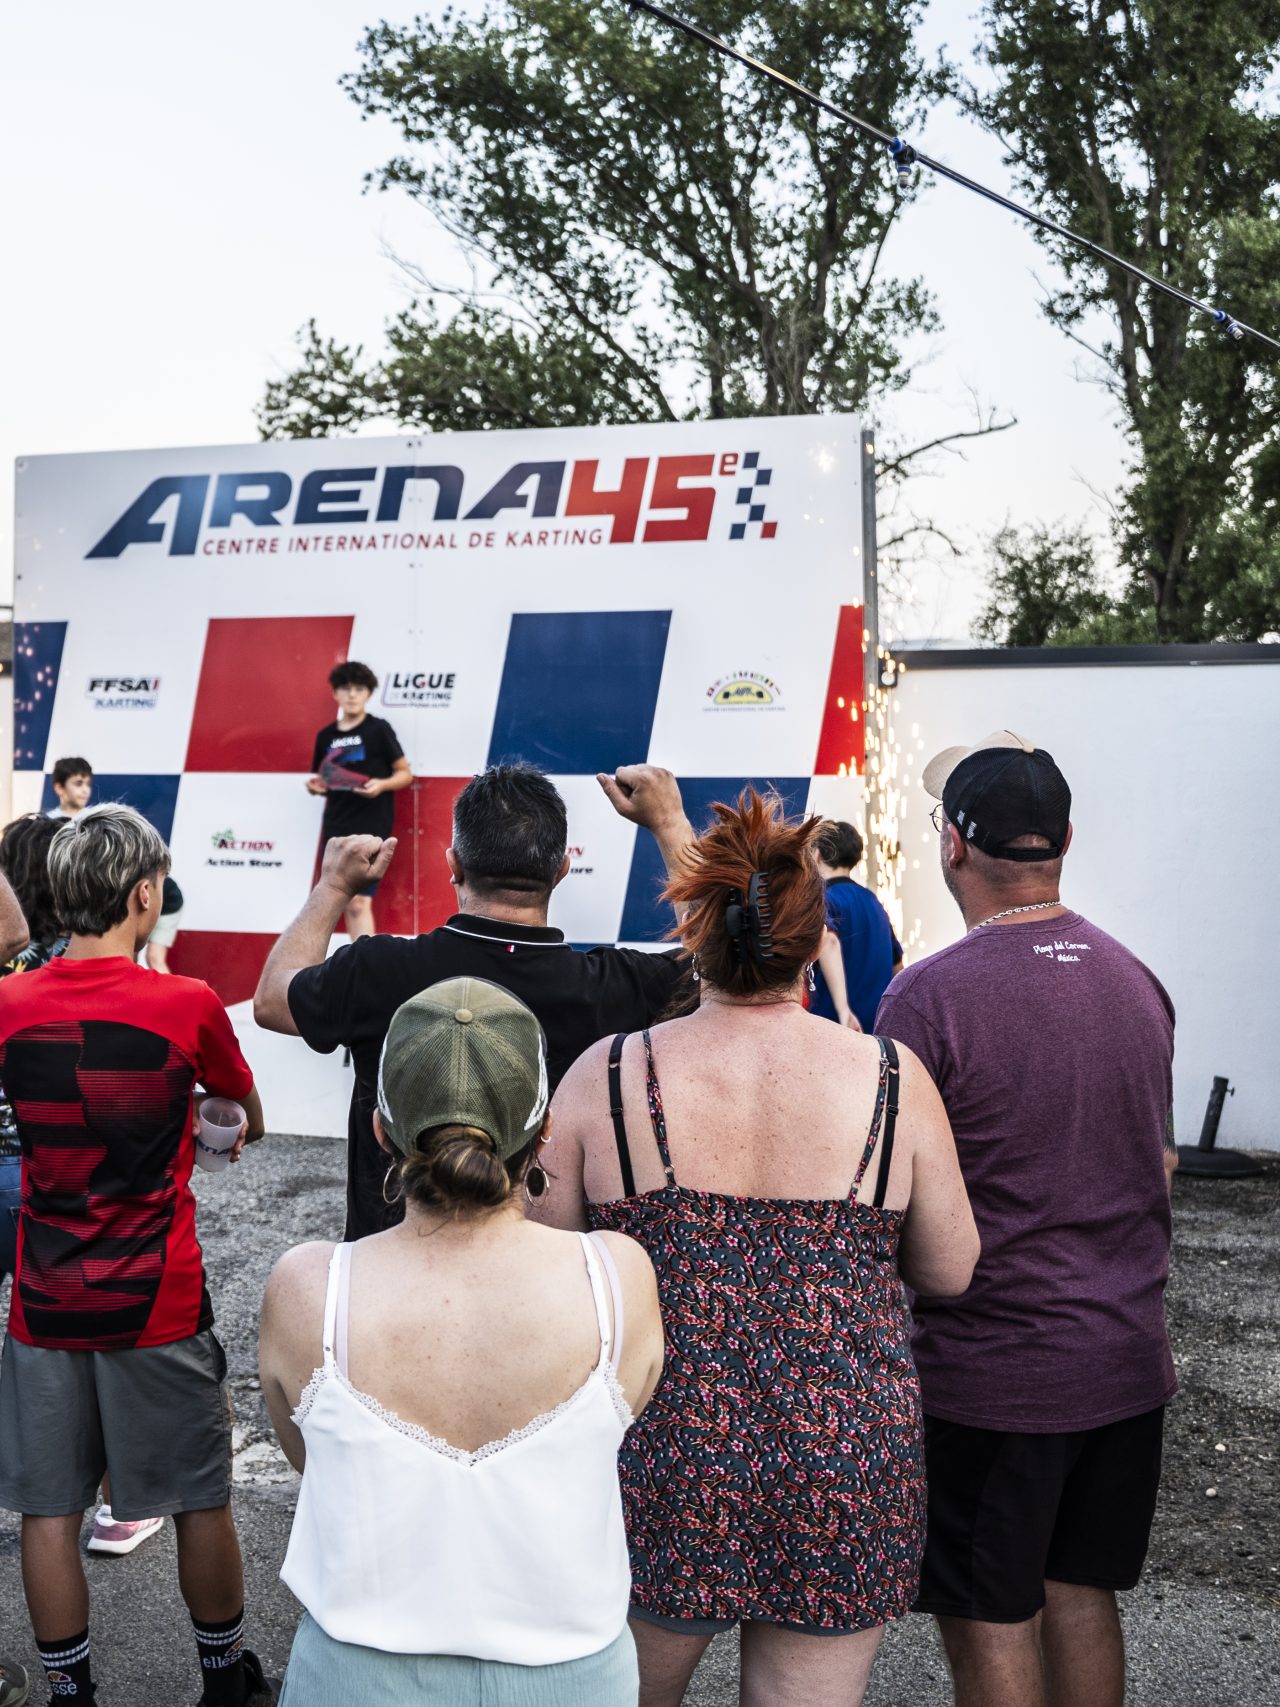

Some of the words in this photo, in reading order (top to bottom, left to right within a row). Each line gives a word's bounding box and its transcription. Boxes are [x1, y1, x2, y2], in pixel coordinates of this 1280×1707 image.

[203, 538, 279, 556] CENTRE
[288, 531, 458, 552] INTERNATIONAL
[470, 532, 495, 548] DE
[507, 528, 603, 547] KARTING
[89, 677, 149, 692] FFSA
[570, 867, 593, 875] ore
